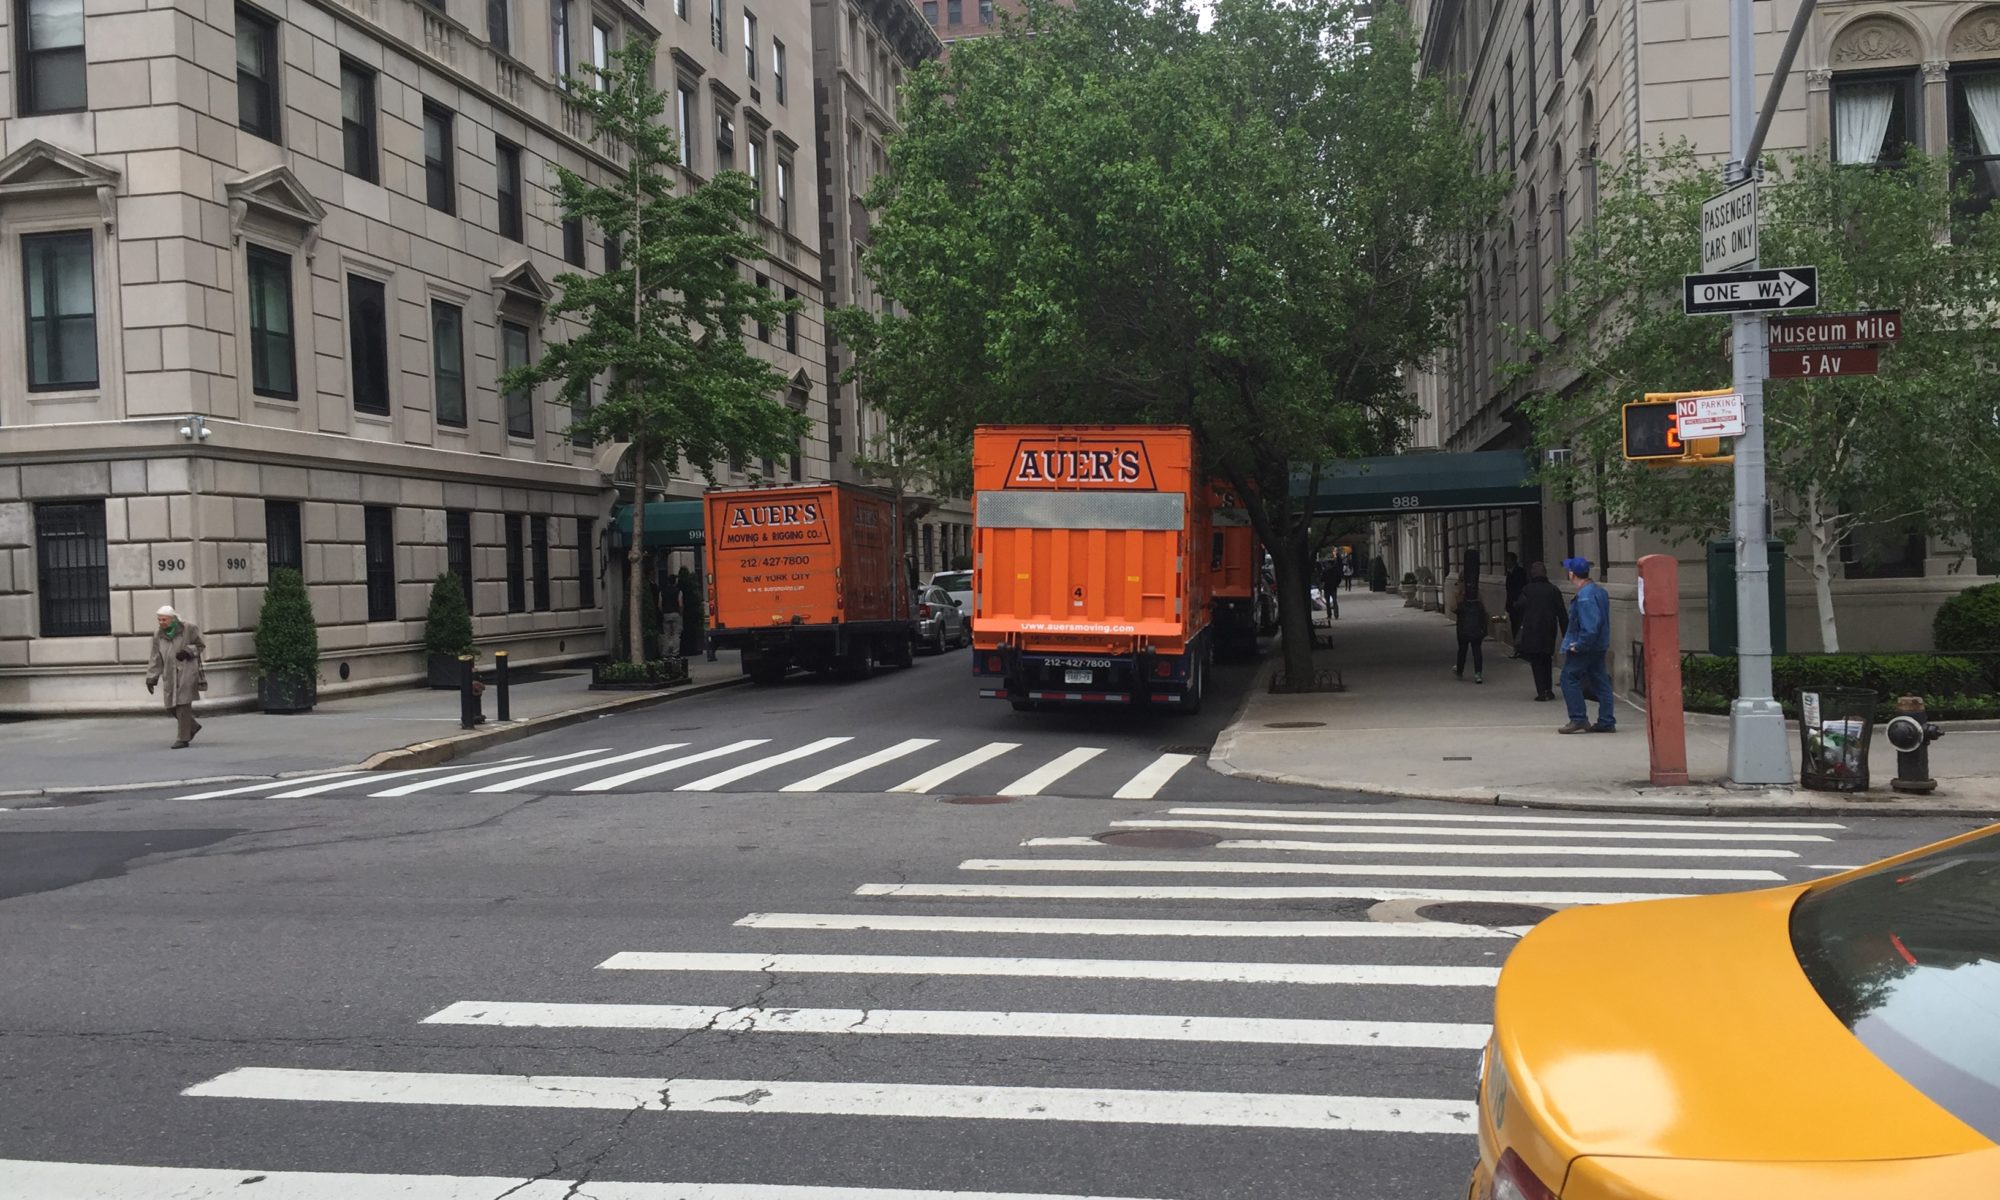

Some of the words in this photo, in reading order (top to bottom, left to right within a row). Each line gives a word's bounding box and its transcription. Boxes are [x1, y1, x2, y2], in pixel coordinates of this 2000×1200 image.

[1704, 192, 1753, 233] PASSENGER
[1704, 235, 1727, 264] CARS
[1731, 224, 1753, 253] ONLY
[1703, 284, 1741, 301] ONE
[1757, 280, 1797, 298] WAY
[1770, 323, 1847, 344] Museum
[1856, 318, 1896, 339] Mile
[1801, 355, 1812, 375] 5
[1819, 354, 1841, 373] Av
[1679, 401, 1697, 416] NO
[1701, 398, 1737, 409] PARKING
[1015, 447, 1140, 483] AUER'S
[1392, 496, 1419, 508] 988
[730, 503, 818, 529] AUER'S
[727, 533, 759, 543] MOVING
[762, 533, 768, 541] &
[772, 530, 804, 541] RIGGING
[158, 559, 186, 571] 990
[226, 558, 247, 570] 990
[742, 575, 762, 583] NEW
[765, 573, 788, 582] YORK
[791, 572, 810, 580] CITY
[1074, 587, 1082, 598] 4
